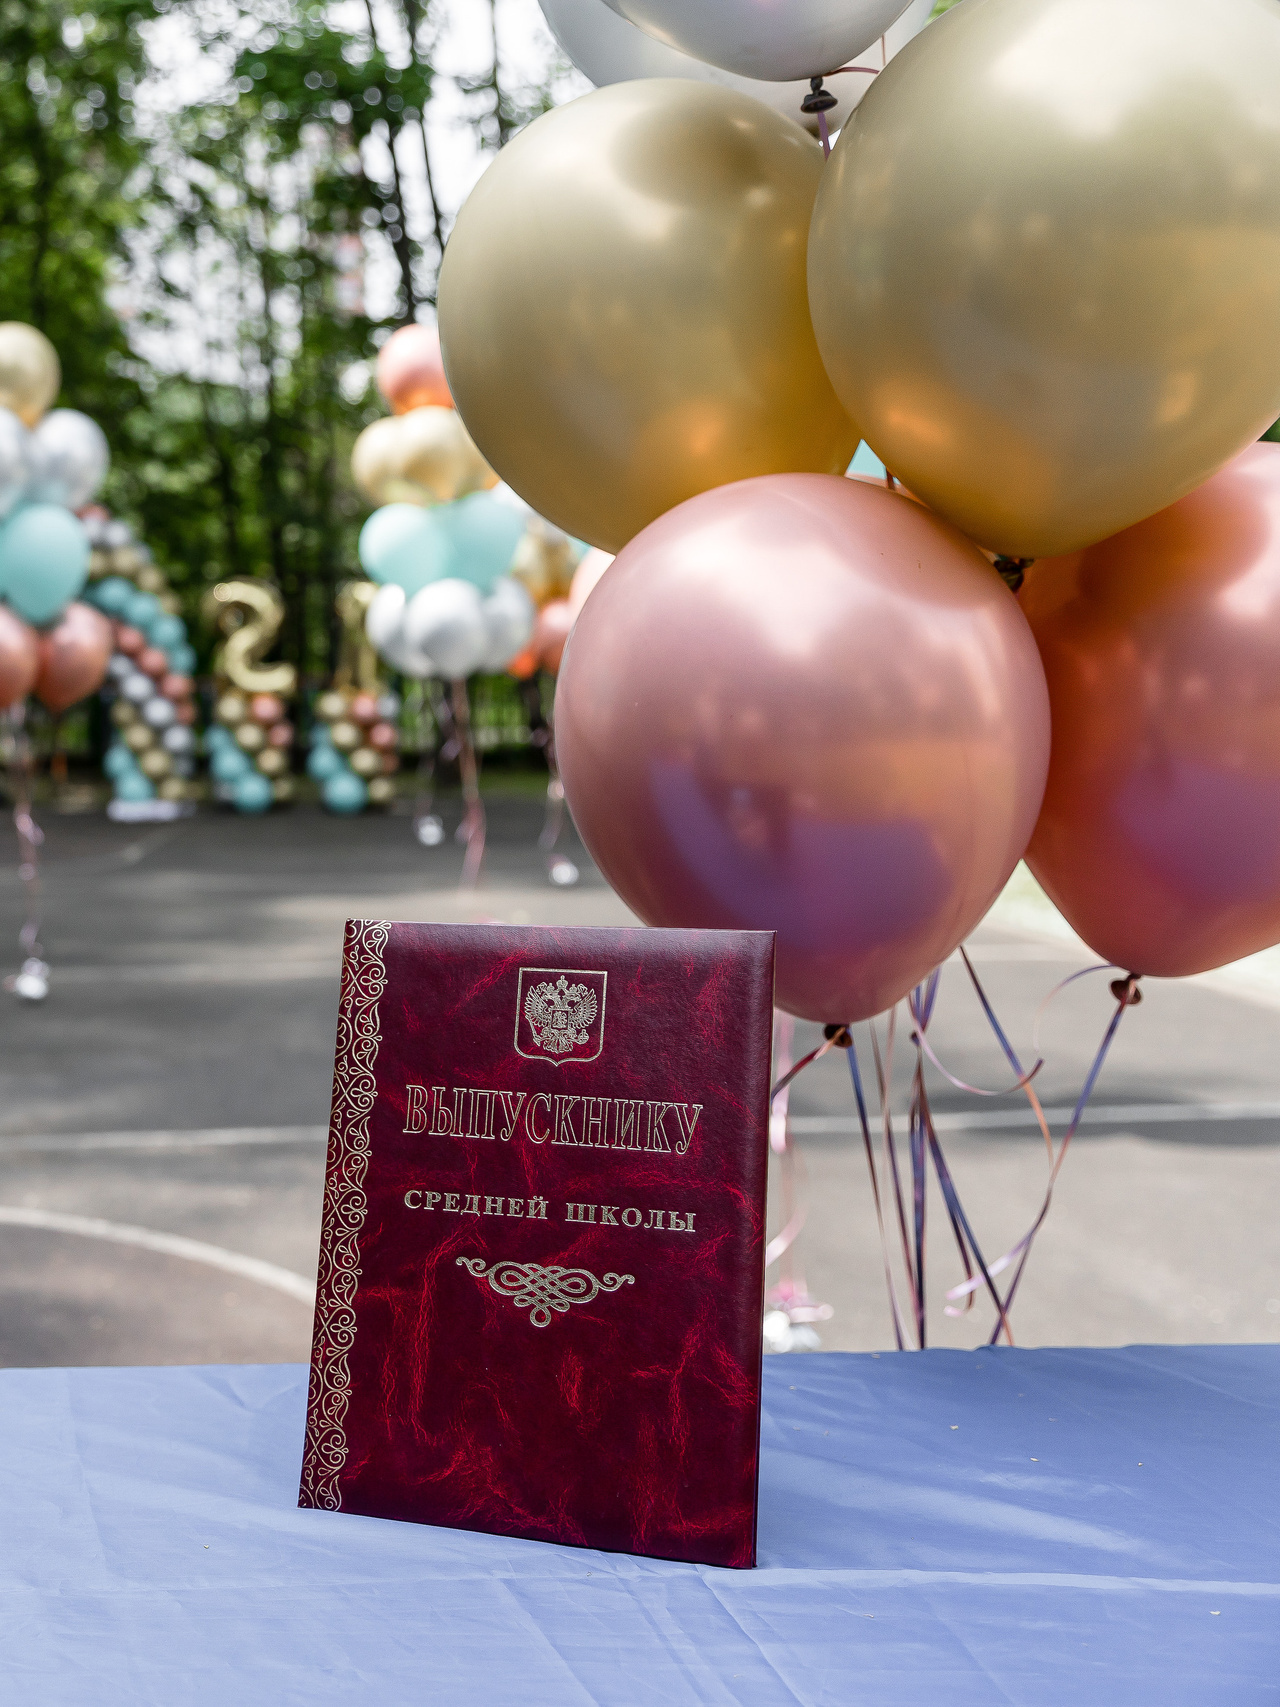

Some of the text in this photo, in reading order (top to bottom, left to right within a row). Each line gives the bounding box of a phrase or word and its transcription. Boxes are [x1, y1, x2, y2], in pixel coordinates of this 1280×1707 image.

[403, 1084, 703, 1155] ВЫПУСКНИКУ
[403, 1189, 697, 1232] СРЕДНЕЙ ШКОЛЫ
